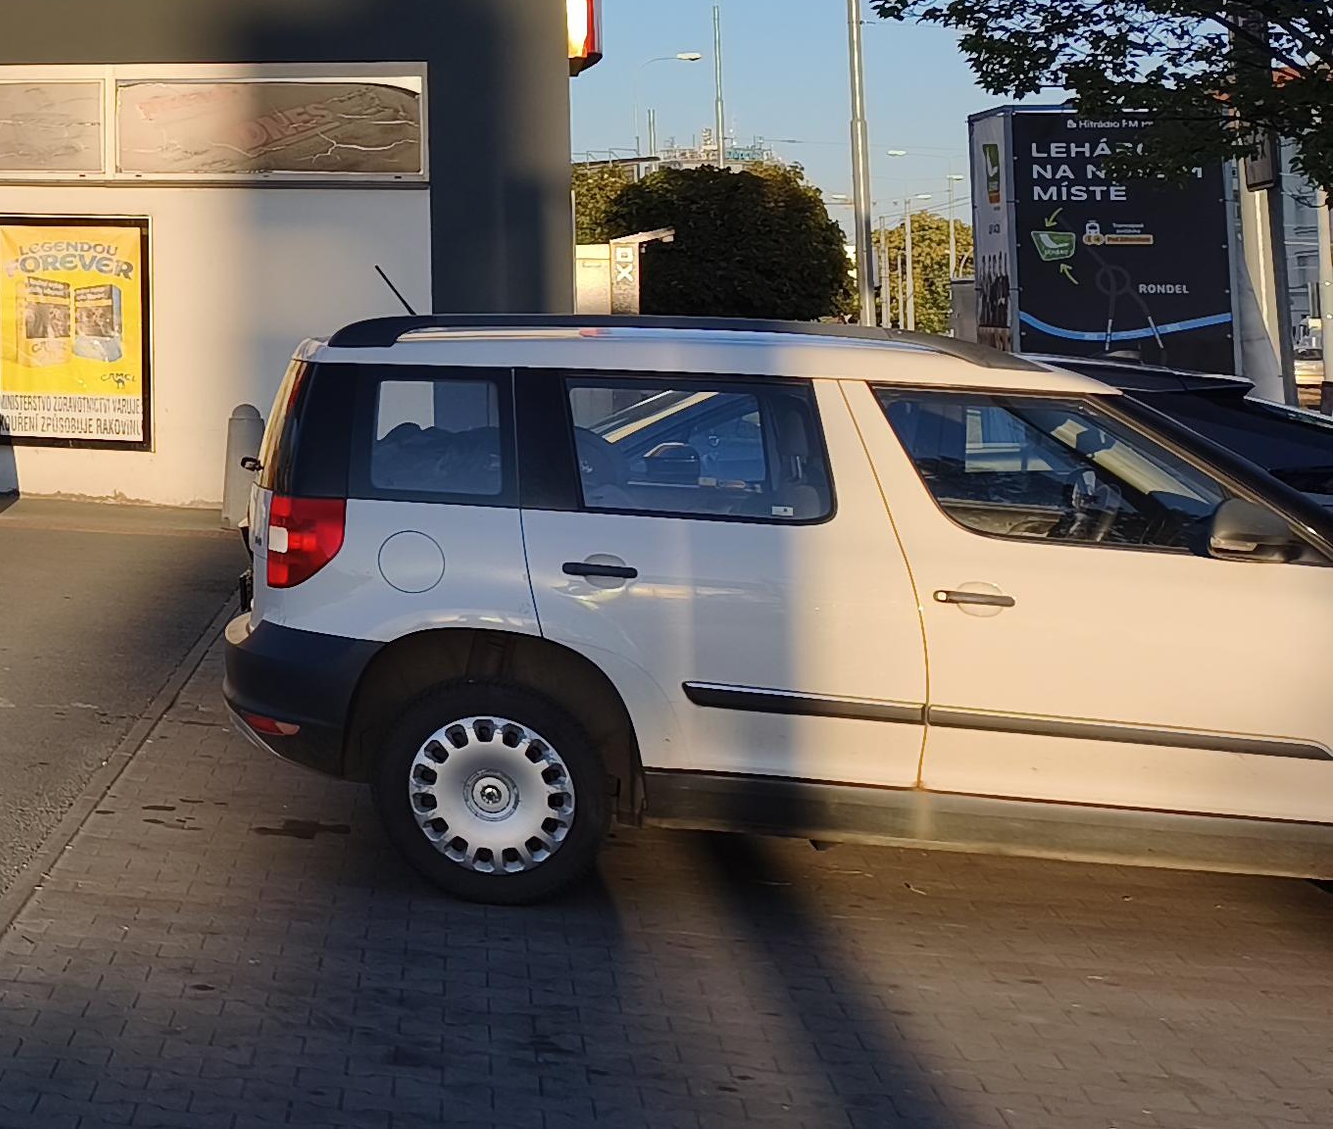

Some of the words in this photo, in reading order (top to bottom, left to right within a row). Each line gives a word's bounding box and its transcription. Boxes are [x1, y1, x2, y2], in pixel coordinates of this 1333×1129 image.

[1033, 164, 1075, 179] NA
[1033, 181, 1127, 201] MÍSTĚ
[19, 241, 118, 257] LEGENDOU
[7, 253, 134, 281] FOREVER
[1138, 284, 1190, 294] RONDEL
[0, 412, 39, 432] KOUŘENÍ
[41, 414, 94, 434] ZPŮSOBUJE
